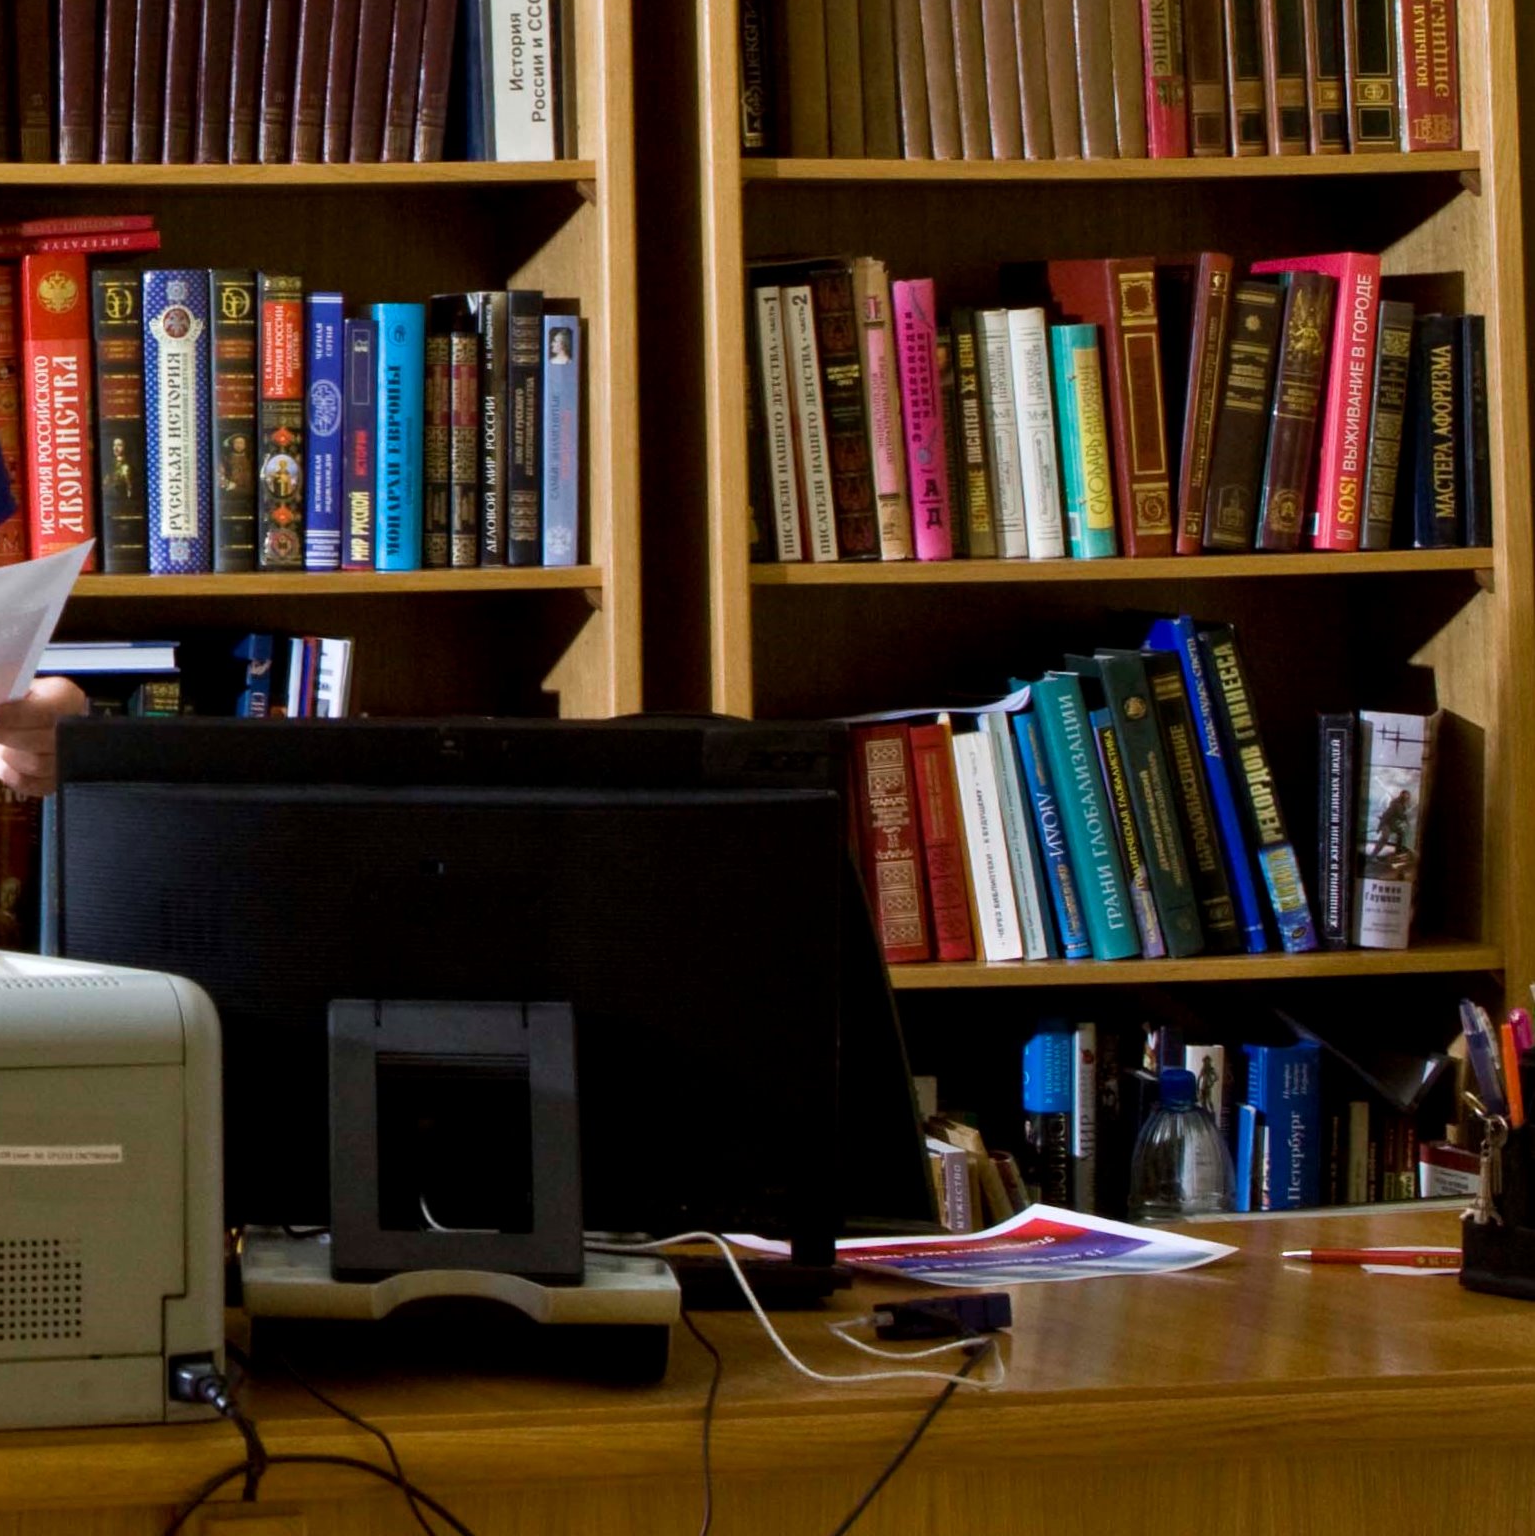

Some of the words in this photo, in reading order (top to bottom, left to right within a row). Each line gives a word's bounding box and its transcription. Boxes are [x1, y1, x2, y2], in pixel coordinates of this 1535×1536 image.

[510, 12, 525, 91] История
[534, 37, 544, 49] и
[1412, 4, 1429, 88] БОЛЬШАЯ
[531, 55, 546, 123] России
[792, 294, 808, 307] 2
[1353, 274, 1372, 342] ГОРОДЕ
[801, 345, 817, 408] ДЕТСТВА
[958, 334, 974, 368] ВЕКА
[961, 376, 975, 393] XX
[1352, 346, 1366, 358] В
[33, 355, 51, 463] РОССИЙСКОГО
[167, 351, 181, 440] ИСТОРИЯ
[388, 365, 401, 454] ЕВРОПЫ
[485, 395, 496, 450] РОССИИ
[1344, 362, 1364, 472] ВЫЖИВАНИЕ
[1431, 344, 1453, 440] АФОРИЗМА
[53, 355, 84, 534] ДВОРЯНСТВА
[806, 412, 822, 477] НАШЕГО
[963, 398, 982, 464] ПИСАТЕЛИ
[40, 465, 55, 535] ИСТОРИЯ
[169, 447, 183, 531] РУССКАЯ
[485, 456, 496, 485] МИР
[969, 469, 989, 533] ВЕЛИКИЕ
[1087, 436, 1107, 516] СЛОВАРЬ
[1338, 475, 1358, 526] SOS!
[1434, 443, 1455, 518] МАСТЕРА
[351, 491, 369, 529] РУССКОЙ
[388, 464, 401, 557] МОНАРХИ
[484, 491, 497, 554] ДЕЛОВОЙ
[811, 481, 830, 554] ПИСАТЕЛИ
[351, 532, 369, 562] МИР
[1213, 642, 1256, 740] ГИННЕССА
[1058, 694, 1108, 857] ГЛОБАЛИЗАЦИИ
[1240, 744, 1285, 845] РЕКОРДОВ
[1099, 863, 1125, 930] ГРАНИ
[1287, 1111, 1303, 1204] Петербург
